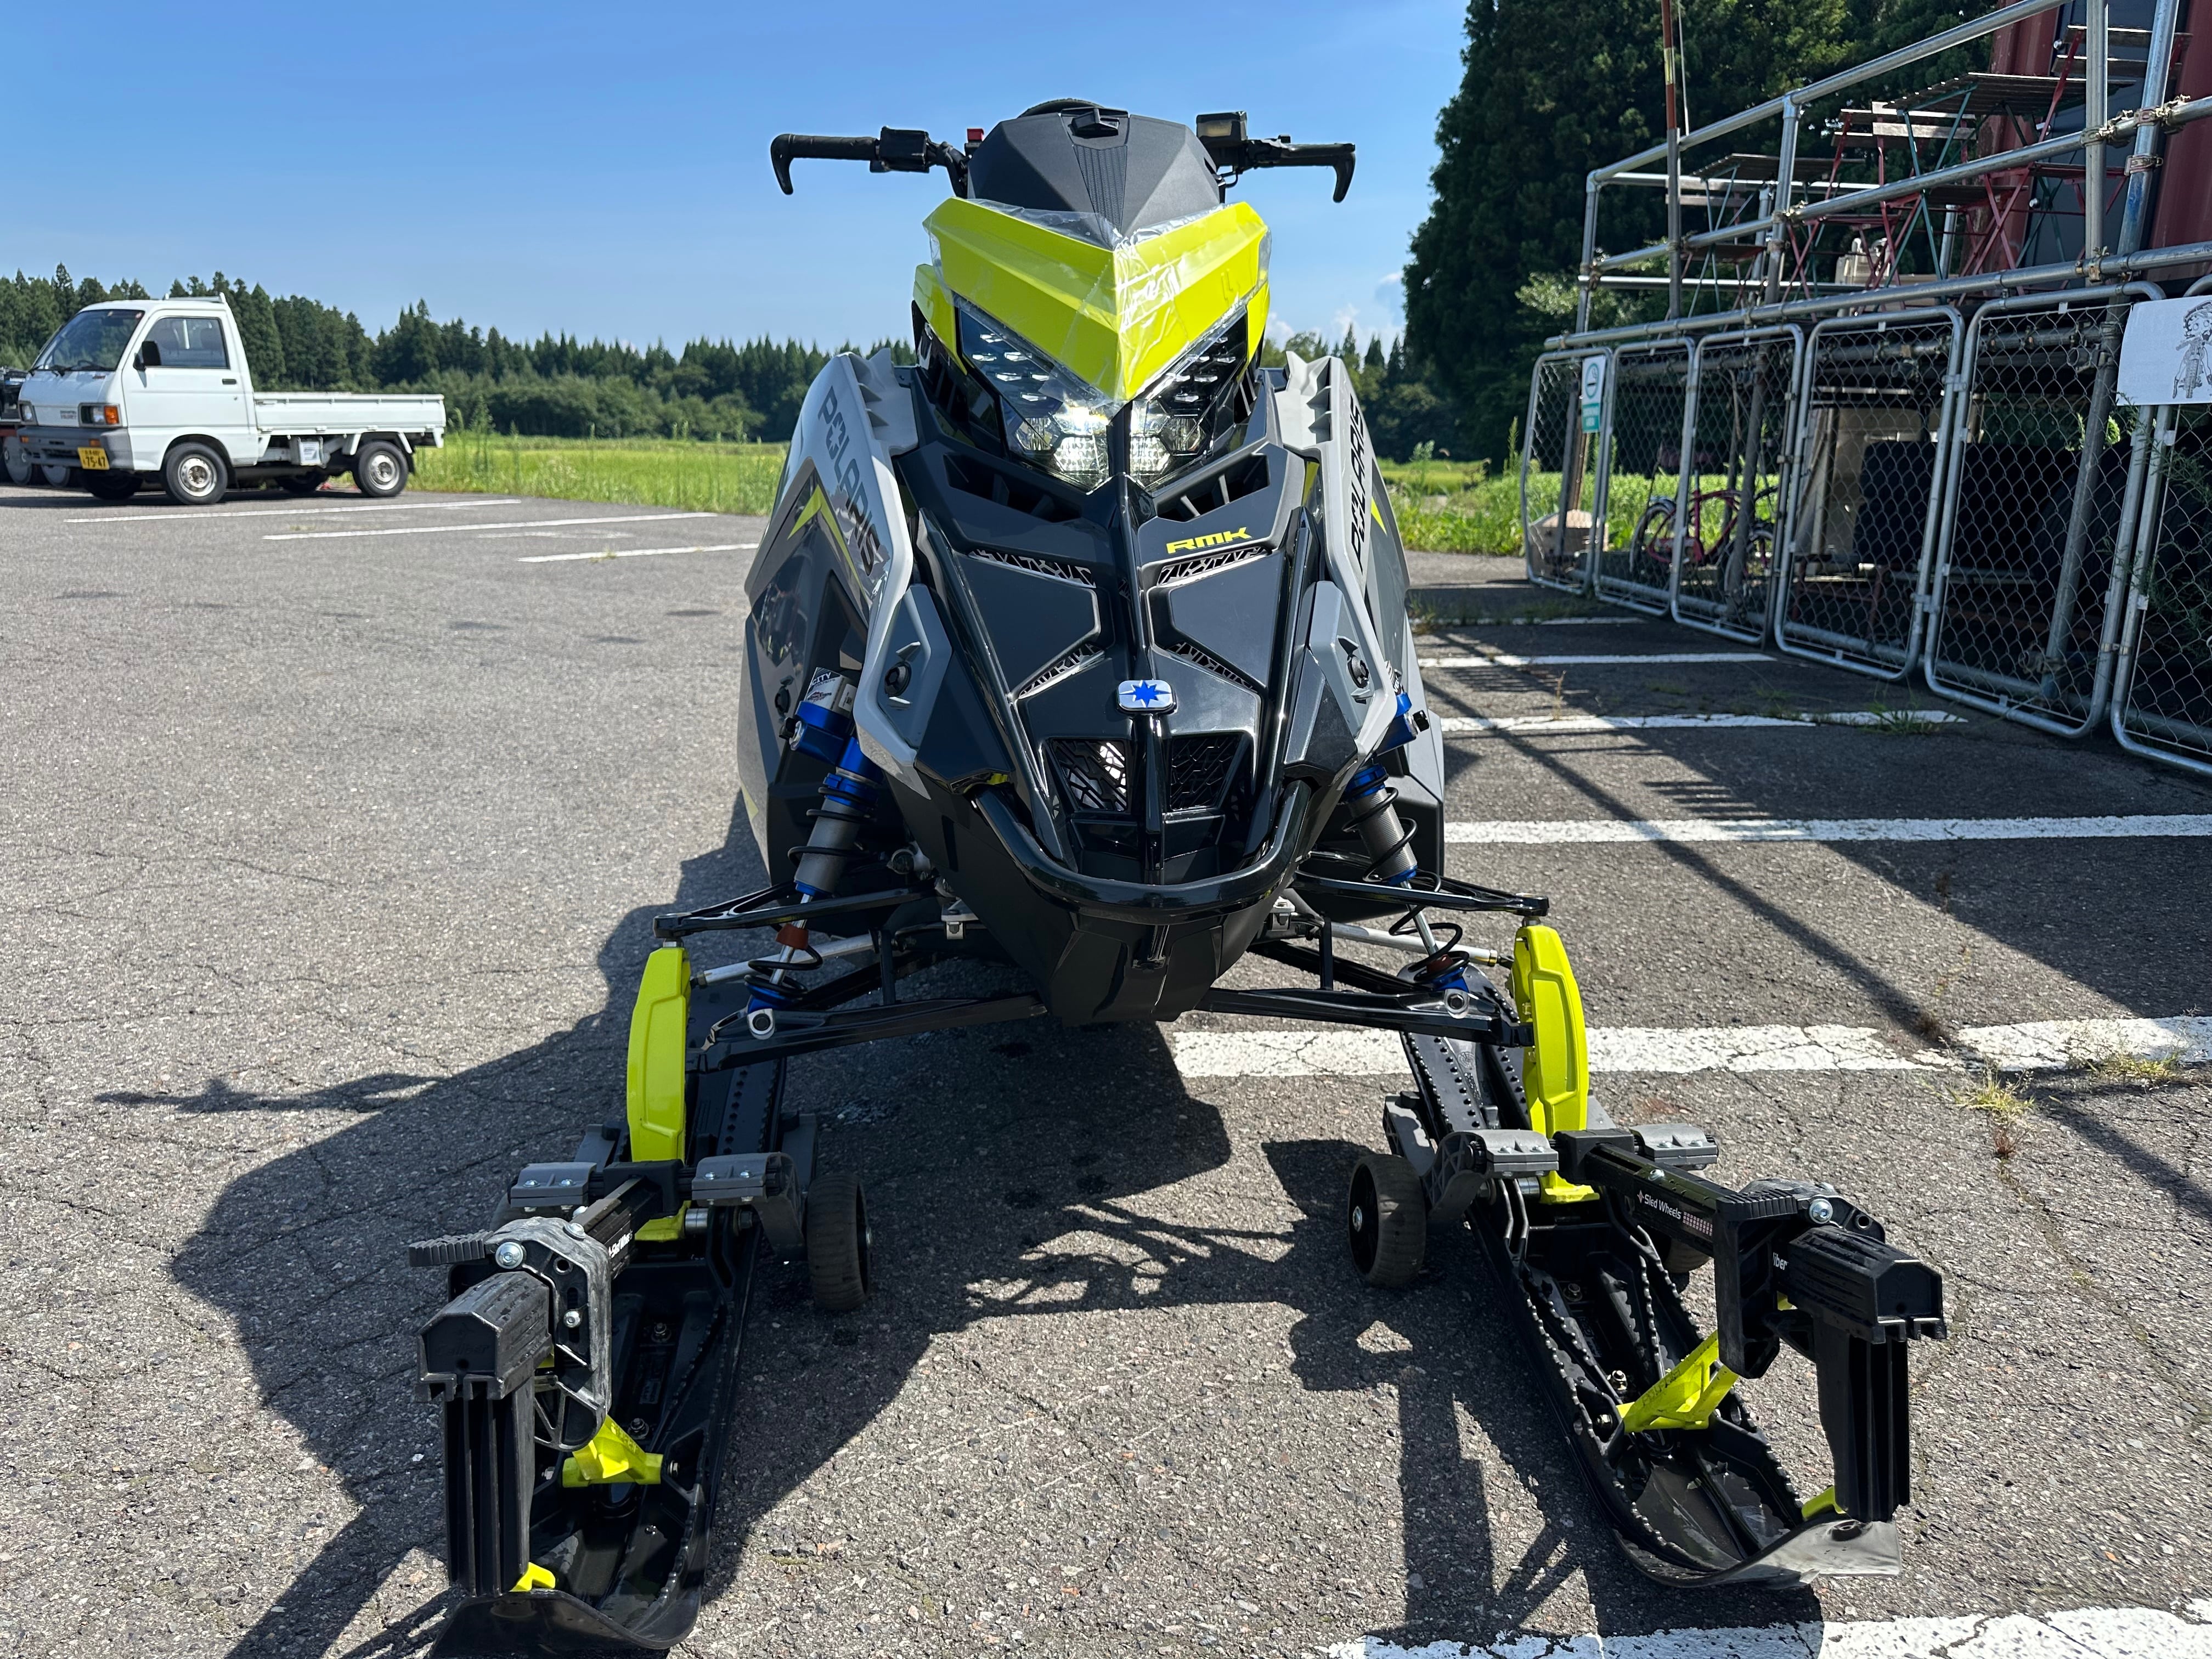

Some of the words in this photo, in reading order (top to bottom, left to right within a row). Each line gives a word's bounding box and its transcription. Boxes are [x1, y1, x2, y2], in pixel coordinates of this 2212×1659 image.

[818, 386, 881, 576] POLARIS
[1350, 393, 1365, 575] POLARIS
[1166, 527, 1252, 554] RMK
[1644, 1194, 1658, 1209] Sled
[1658, 1199, 1682, 1220] Wheels
